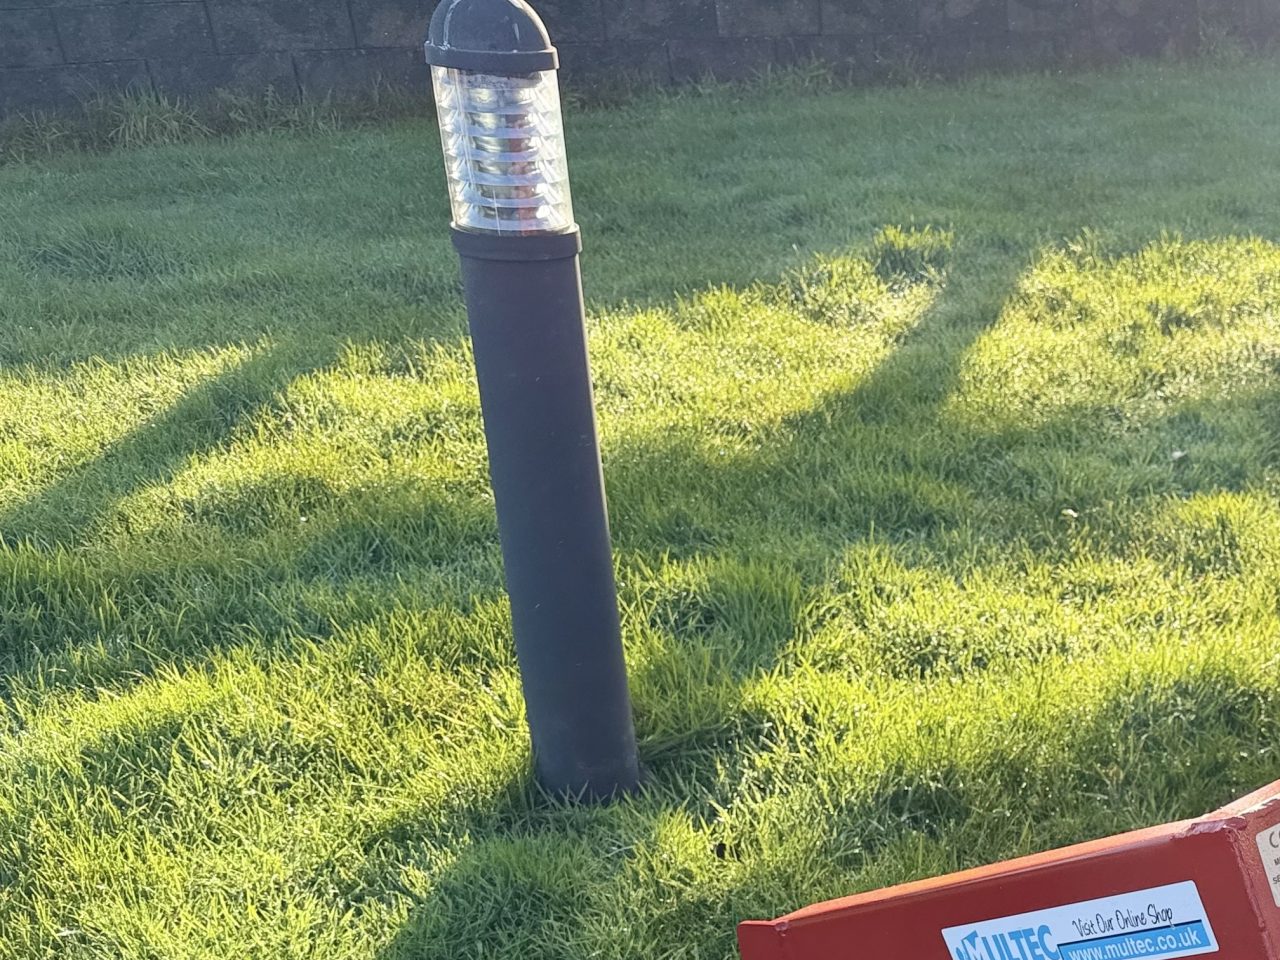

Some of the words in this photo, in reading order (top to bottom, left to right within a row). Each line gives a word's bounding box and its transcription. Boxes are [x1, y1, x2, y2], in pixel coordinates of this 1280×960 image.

[1072, 916, 1097, 938] Visit
[1096, 912, 1115, 934] Our
[1116, 908, 1148, 931] Online
[1147, 903, 1174, 931] Shop
